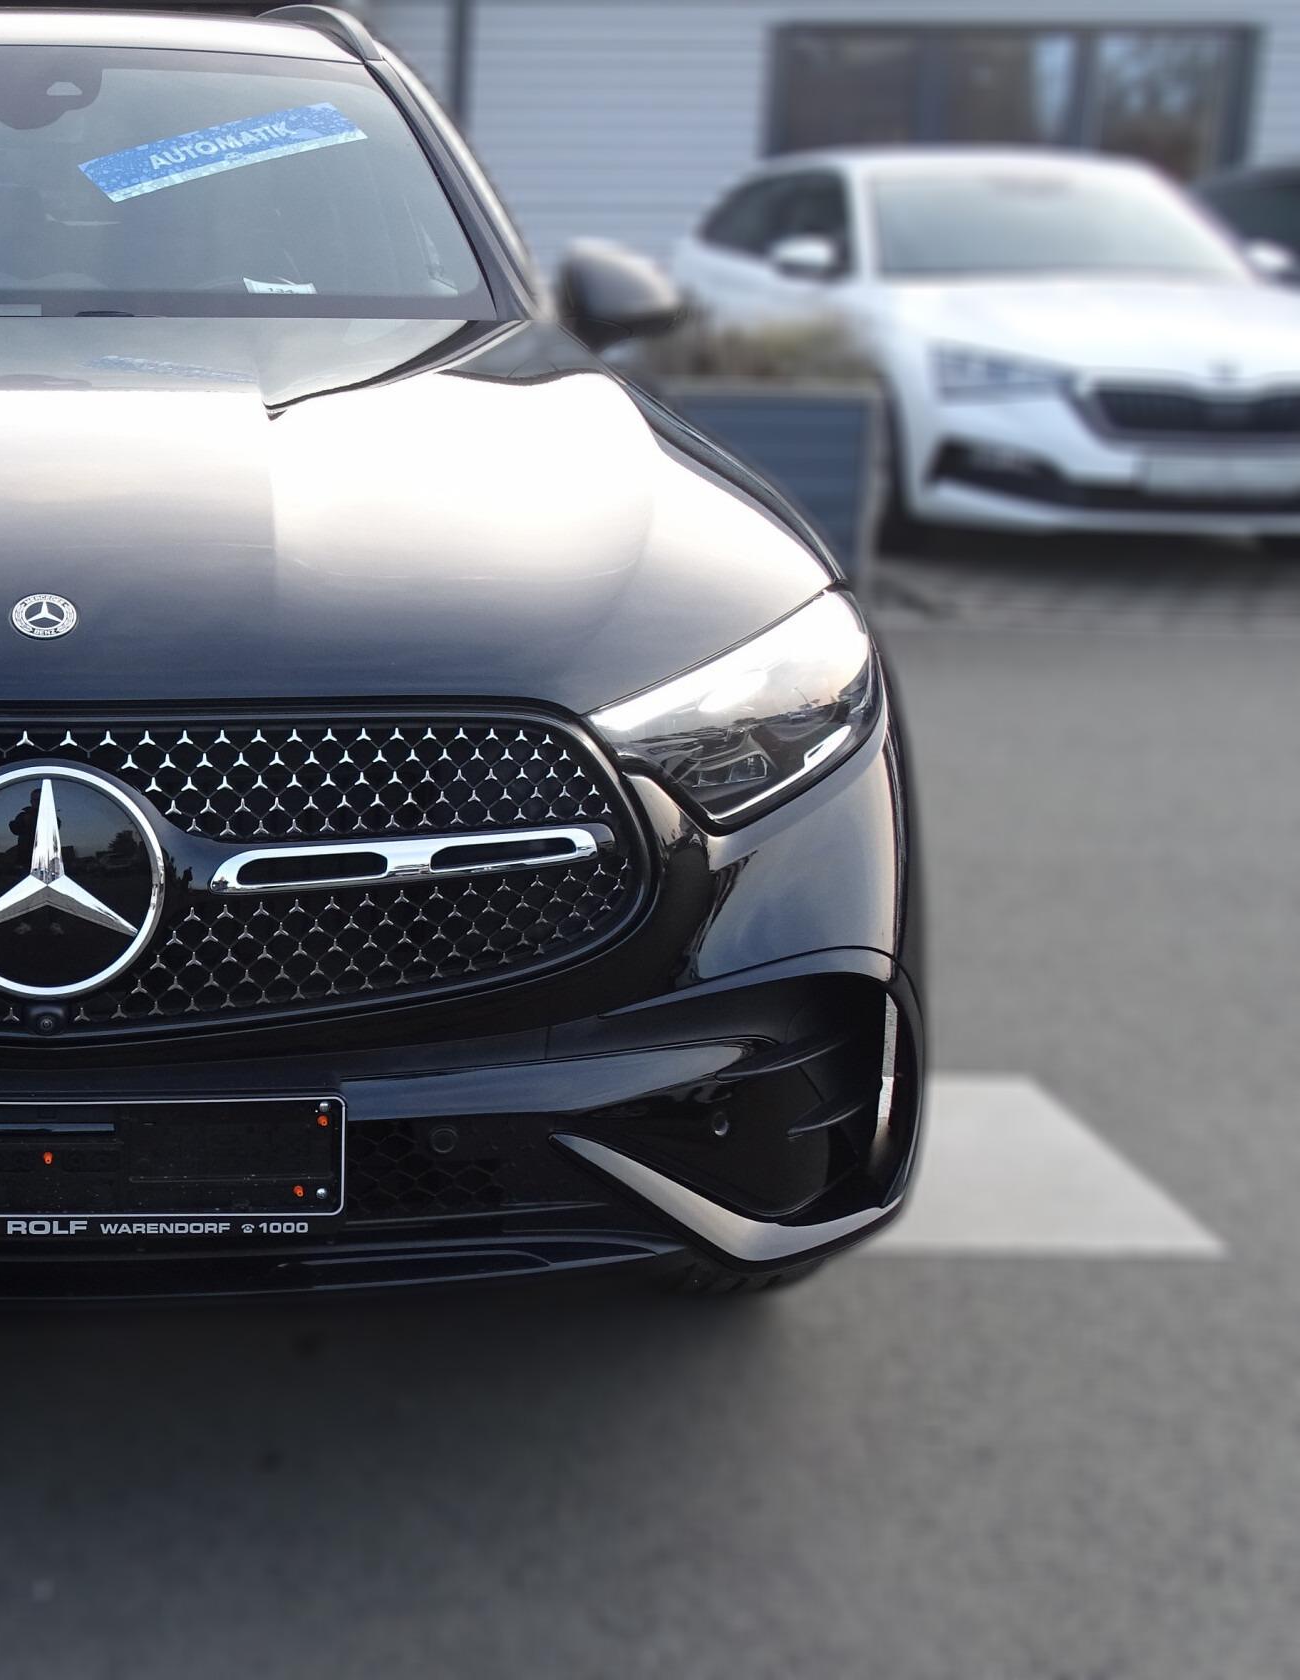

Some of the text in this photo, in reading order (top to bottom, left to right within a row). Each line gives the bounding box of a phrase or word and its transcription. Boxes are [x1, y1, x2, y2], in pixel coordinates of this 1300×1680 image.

[149, 120, 297, 170] AUTOMATIK
[6, 1220, 88, 1235] ROLF
[100, 1222, 231, 1234] WARENDORF
[258, 1222, 309, 1234] 1000
